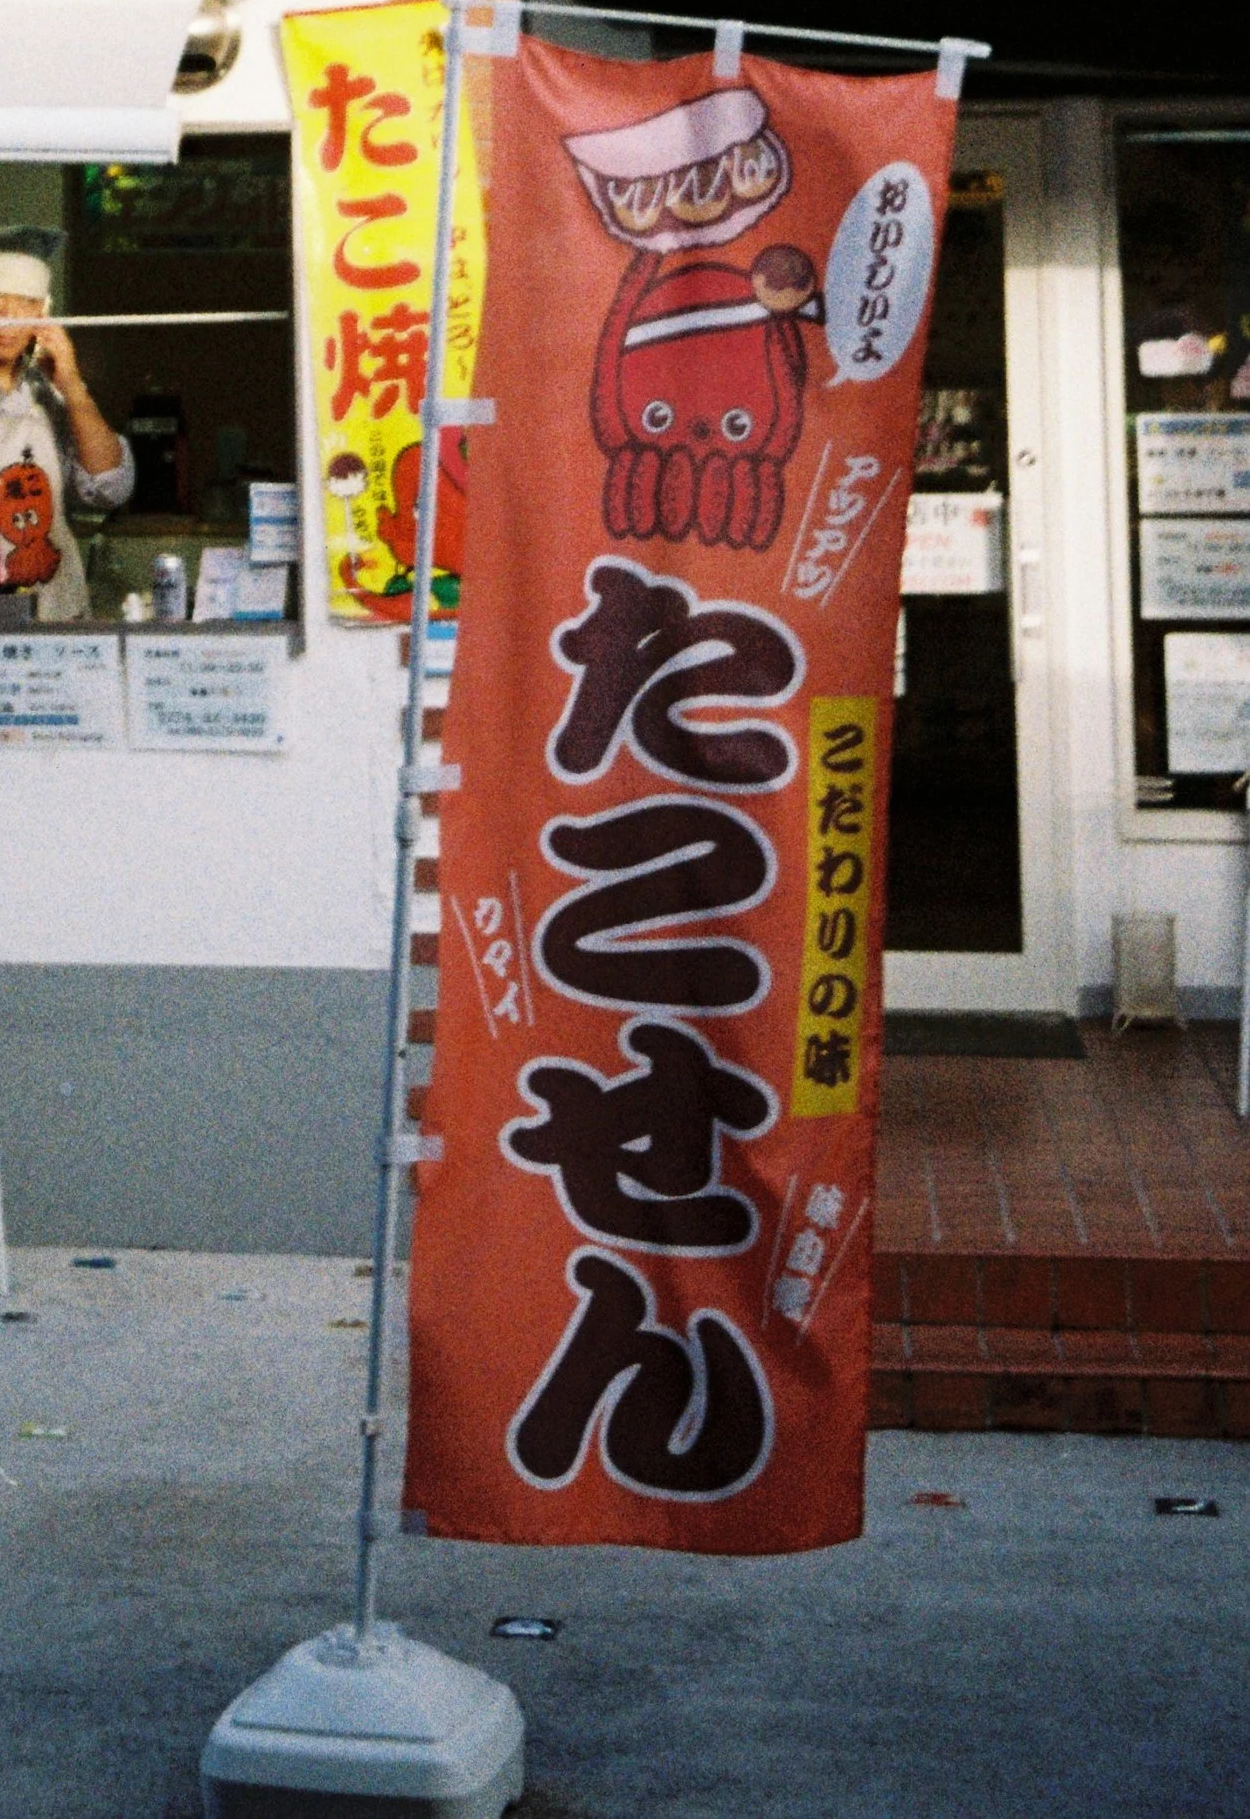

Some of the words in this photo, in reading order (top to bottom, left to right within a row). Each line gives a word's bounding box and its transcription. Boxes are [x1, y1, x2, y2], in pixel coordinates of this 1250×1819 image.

[852, 177, 910, 365] おいしいよ
[498, 555, 806, 1502] たこせん
[806, 722, 866, 1089] こだわりの味
